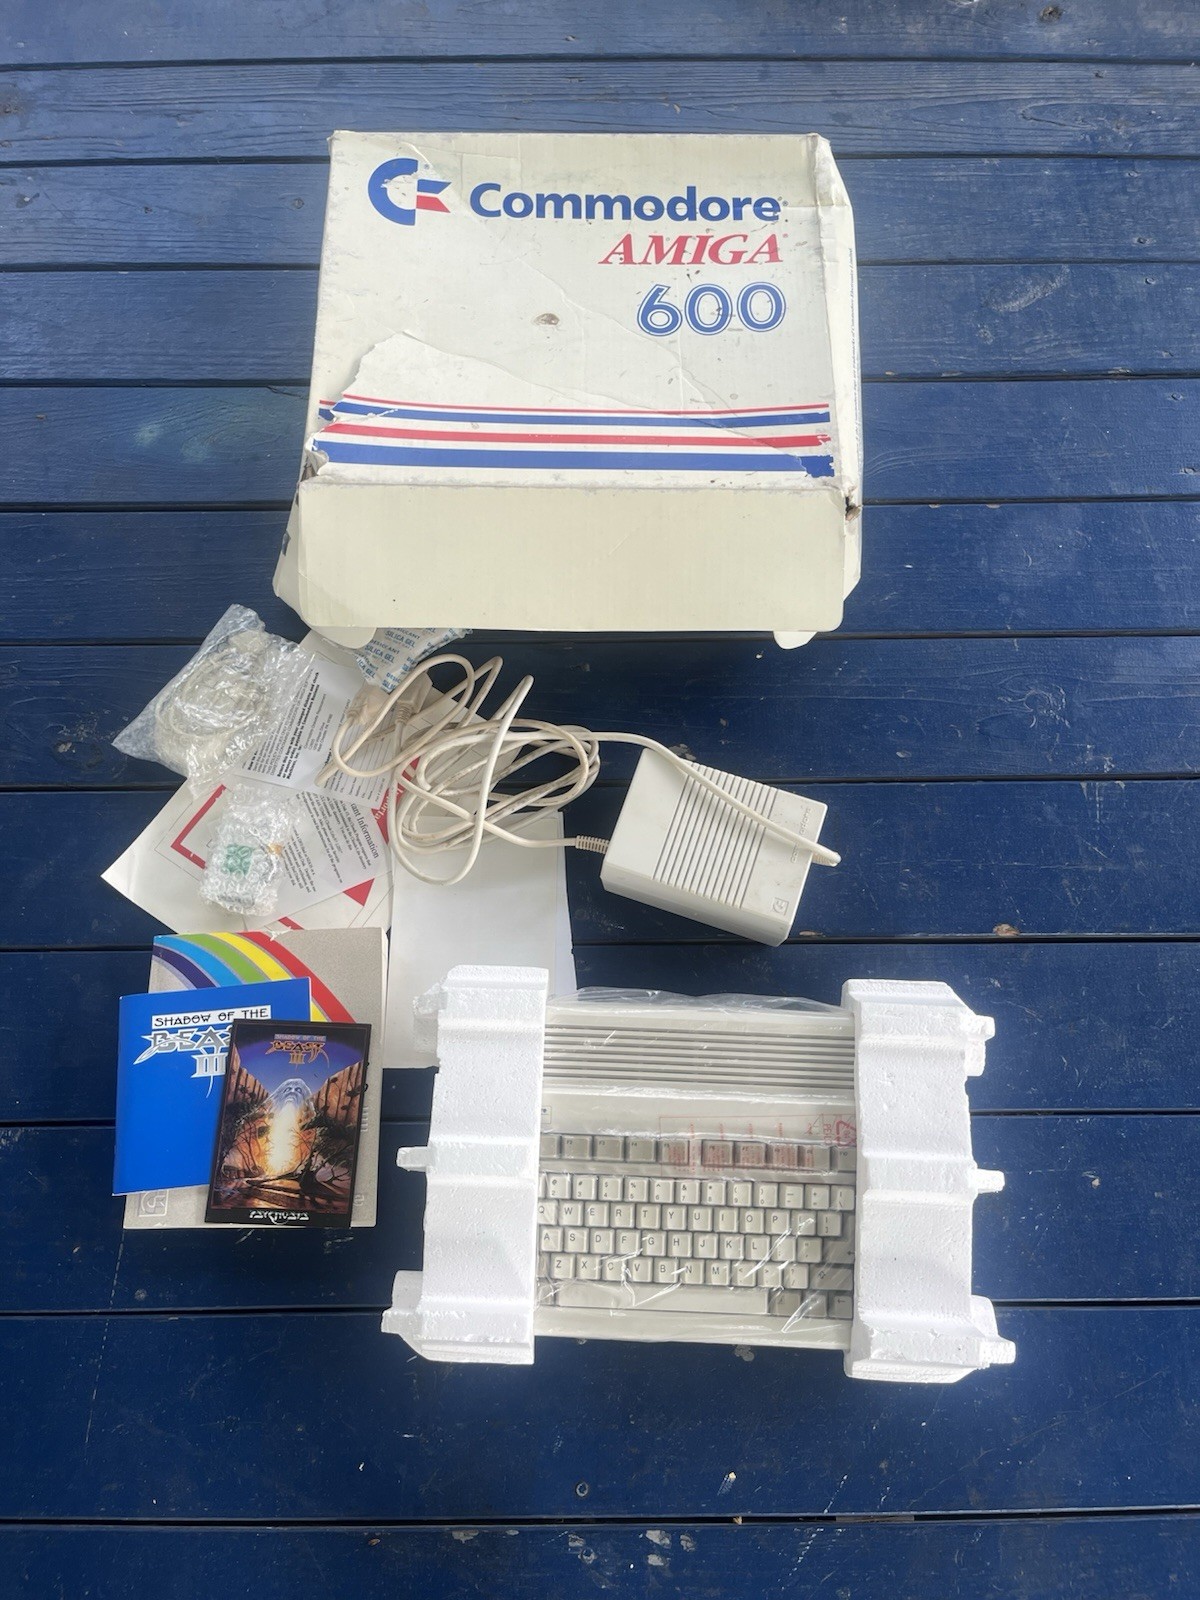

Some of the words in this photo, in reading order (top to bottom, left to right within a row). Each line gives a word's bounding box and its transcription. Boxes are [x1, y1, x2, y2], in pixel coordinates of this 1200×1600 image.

[470, 182, 781, 222] Commodore
[598, 233, 783, 265] AMIGA
[637, 282, 786, 336] 600
[365, 644, 384, 658] SILICA
[384, 653, 395, 663] GEL
[385, 630, 404, 642] SILICA
[404, 638, 416, 648] GEL
[356, 816, 380, 859] Information
[154, 1010, 211, 1027] SHADOW
[218, 1010, 235, 1021] OF
[241, 1007, 269, 1020] THE
[134, 1026, 232, 1064] BEAS
[265, 1040, 326, 1060] BEAST
